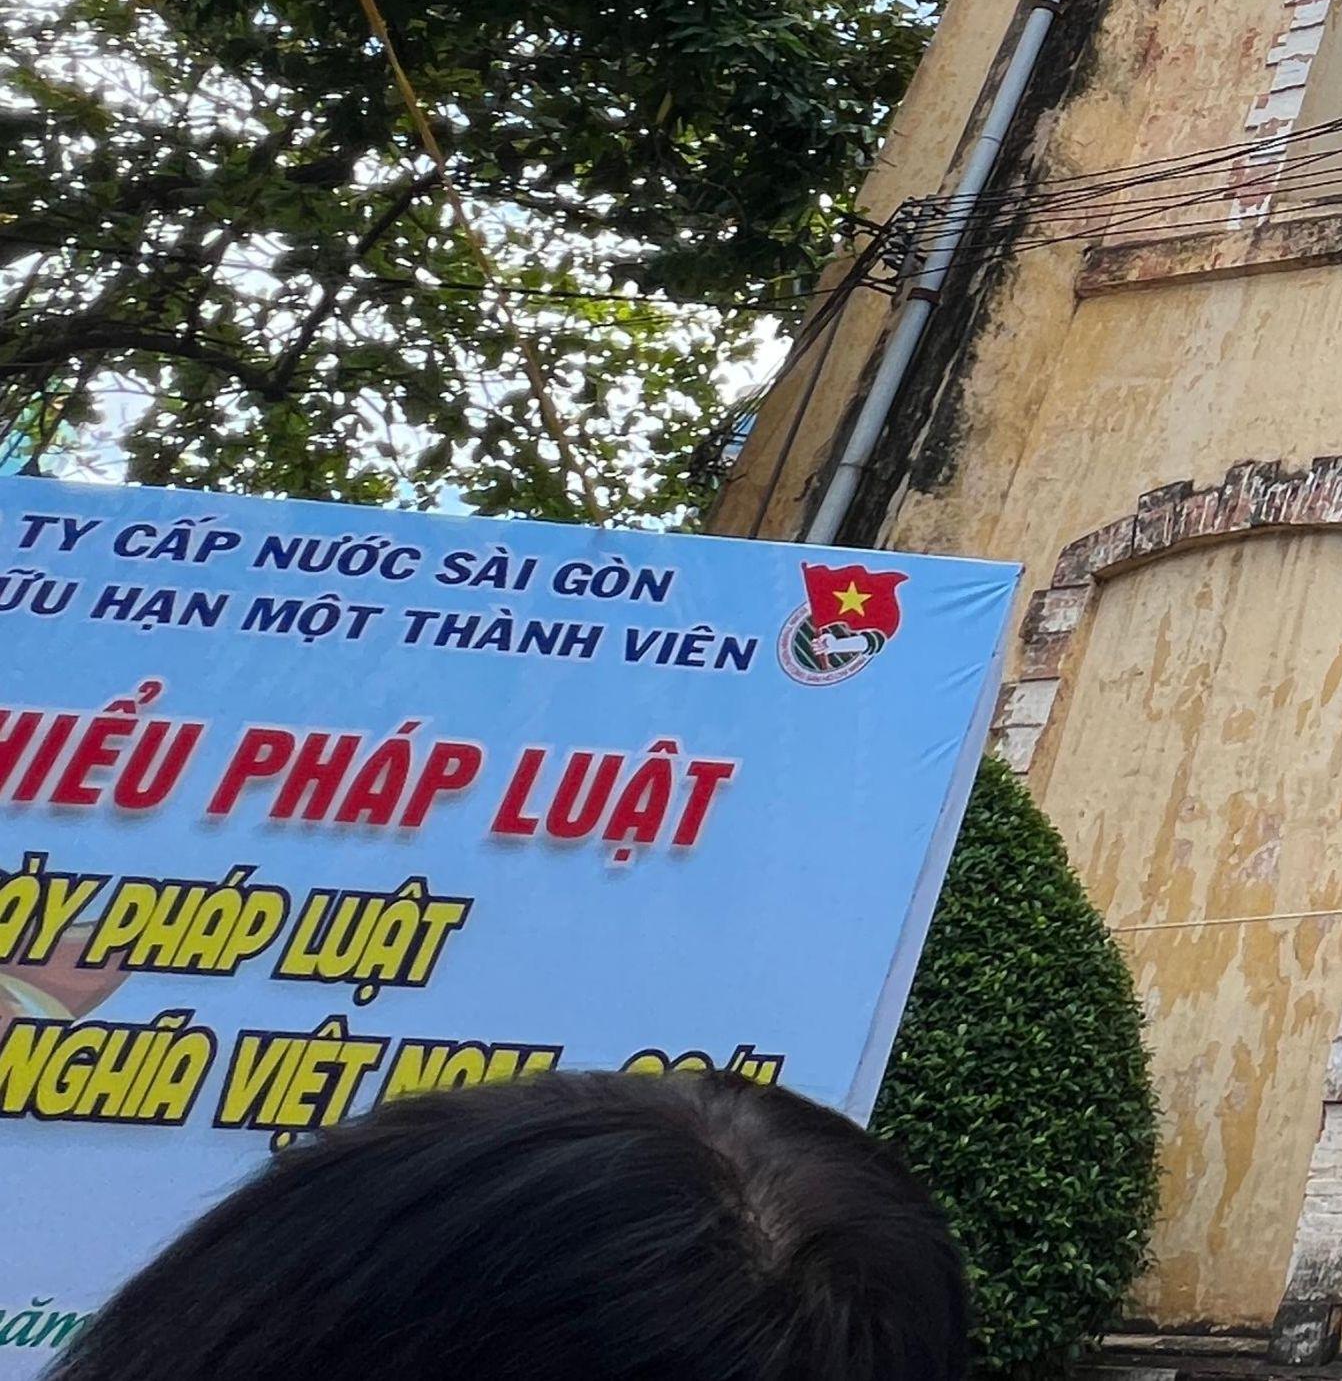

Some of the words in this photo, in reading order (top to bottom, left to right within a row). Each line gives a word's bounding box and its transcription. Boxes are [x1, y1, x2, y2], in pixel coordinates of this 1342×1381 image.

[19, 514, 102, 551] TY
[113, 516, 241, 563] CẤP
[253, 534, 421, 580] NƯỚC
[435, 546, 537, 591] SÀI
[553, 556, 675, 603] GÒN
[90, 585, 230, 631] HẠN
[241, 593, 384, 643] MỘT
[405, 608, 604, 659] THÀNH
[625, 625, 758, 671] VIÊN
[207, 721, 482, 827] PHÁP
[491, 739, 735, 862] LUẬT
[76, 865, 292, 977] PHÁP
[271, 875, 474, 1006] LUẬT
[0, 1009, 218, 1127] NGHĨA
[212, 1015, 392, 1154] VIỆT
